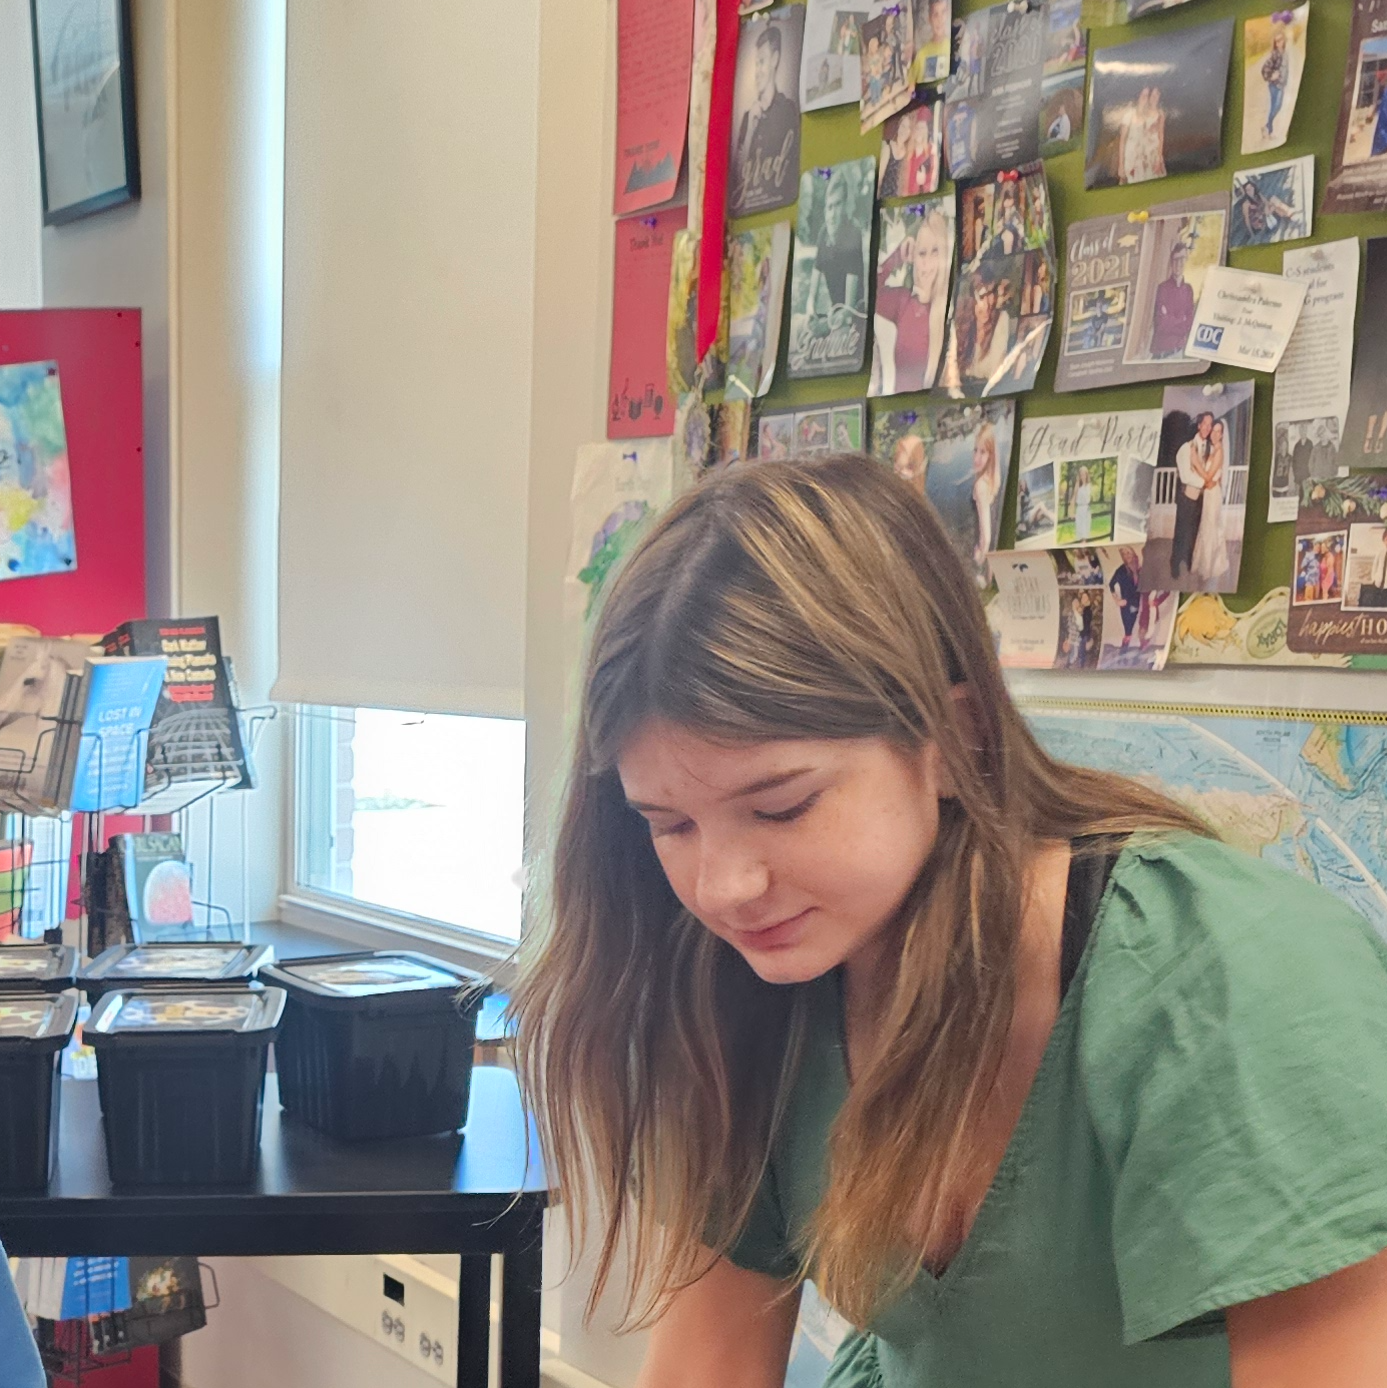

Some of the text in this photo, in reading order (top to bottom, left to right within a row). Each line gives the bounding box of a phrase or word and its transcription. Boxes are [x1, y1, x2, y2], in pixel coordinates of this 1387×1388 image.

[1071, 252, 1131, 285] 2021
[1196, 325, 1225, 346] CDC
[1101, 415, 1160, 460] Party
[98, 705, 143, 722] LOST IN
[100, 723, 134, 736] SPACE
